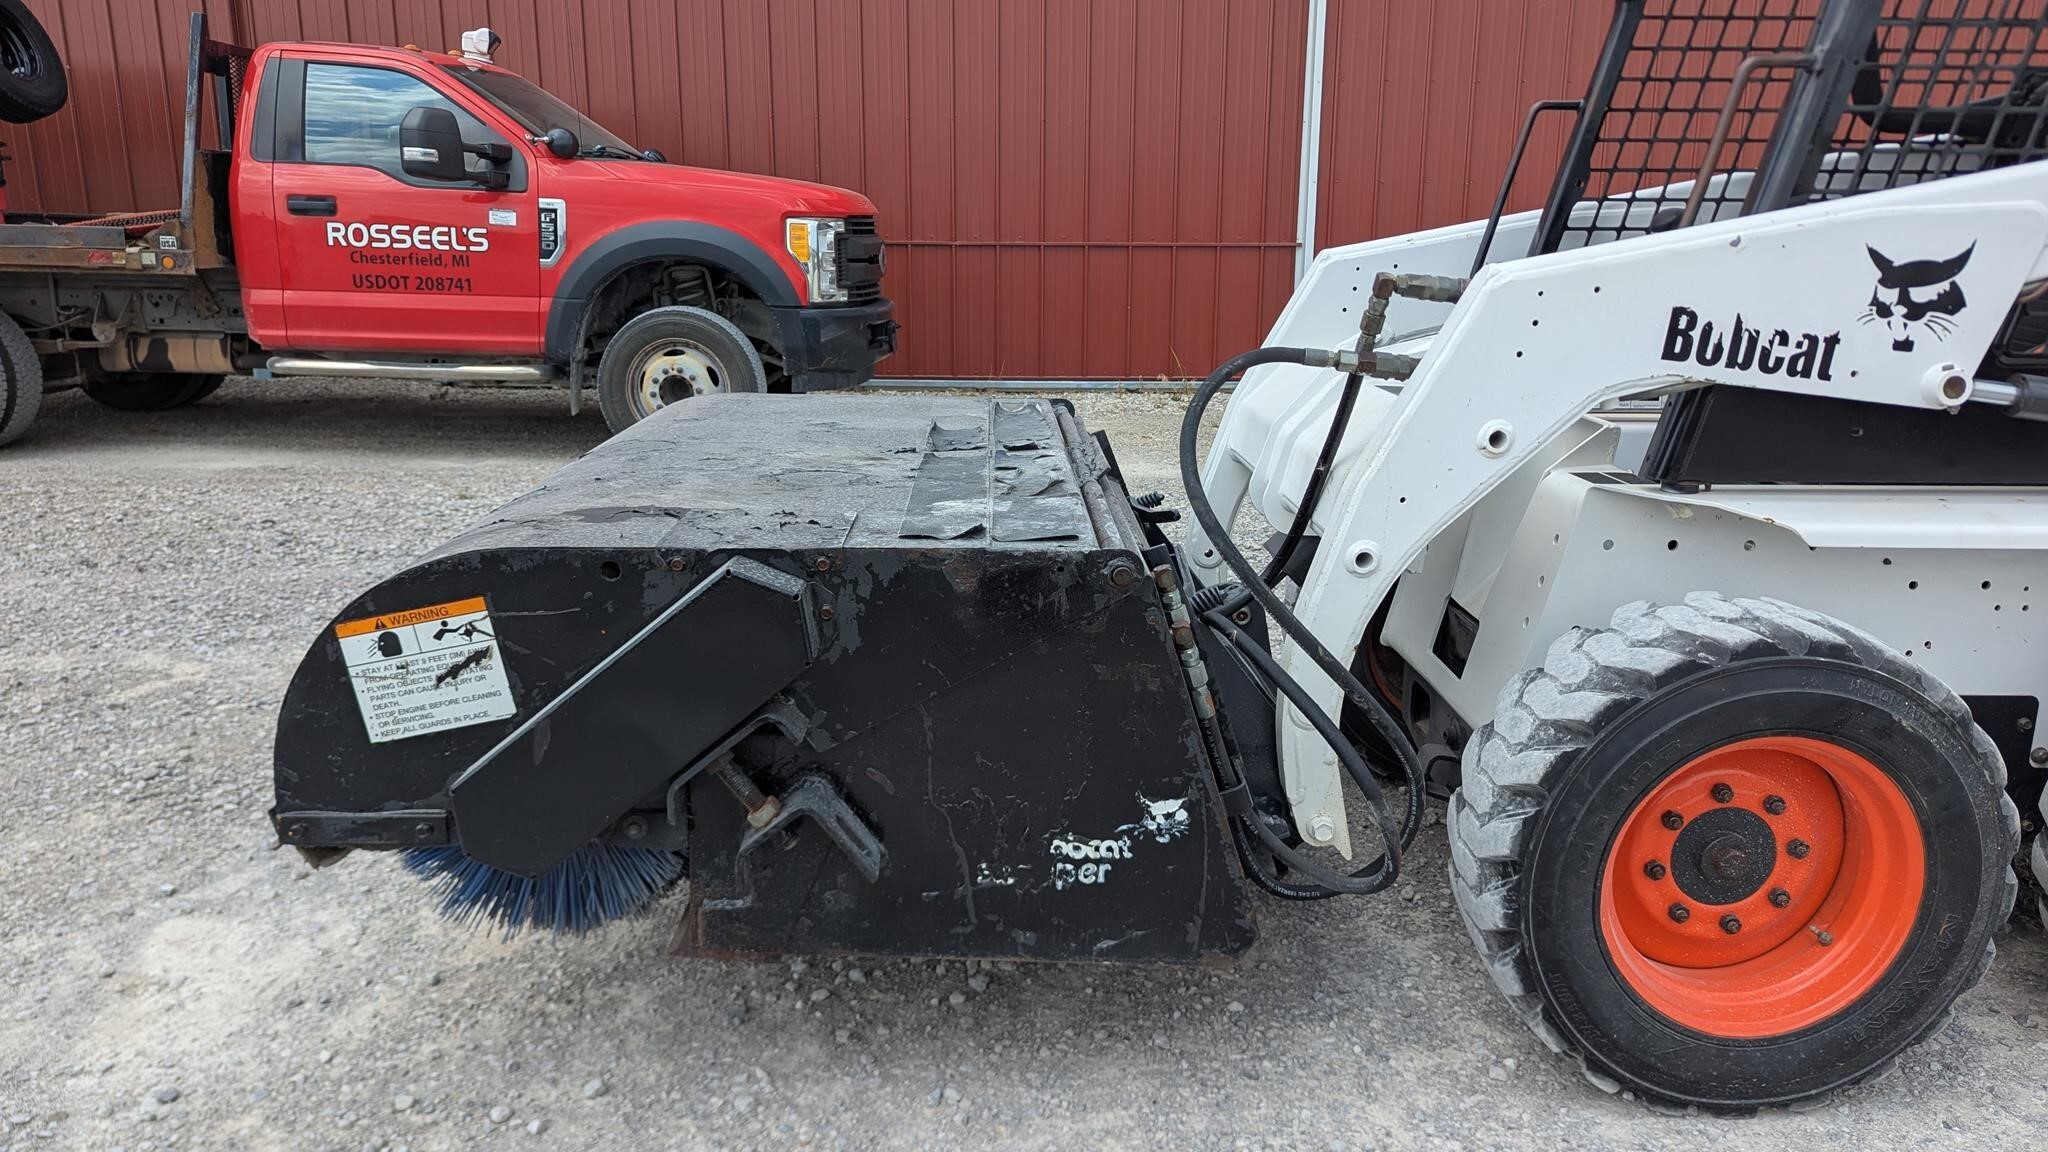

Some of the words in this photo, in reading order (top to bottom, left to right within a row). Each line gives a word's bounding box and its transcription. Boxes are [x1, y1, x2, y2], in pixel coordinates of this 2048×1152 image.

[326, 221, 489, 252] ROSSEEL'S
[350, 250, 448, 268] Chesterfield,
[452, 254, 470, 267] MI
[352, 274, 410, 290] USDOT
[415, 276, 472, 292] 208741
[1661, 305, 1841, 382] Bobcat
[388, 606, 449, 626] WARNING
[361, 666, 381, 676] STAY
[384, 664, 393, 672] AT
[428, 654, 448, 663] FEET
[364, 674, 389, 684] FROM
[390, 665, 435, 680] OPERATING
[366, 682, 395, 693] FLYING
[396, 675, 433, 687] OBJECTS
[369, 692, 397, 702] PARTS
[398, 688, 414, 697] CAN
[474, 674, 487, 682] OR
[372, 700, 402, 711] DEATH.
[375, 710, 396, 720] STOP
[398, 704, 428, 715] ENGINE
[429, 698, 460, 709] BEFORE
[461, 690, 502, 703] CLEANING
[378, 720, 390, 728] OR
[380, 728, 400, 737] KEEP
[402, 724, 417, 734] ALL
[419, 717, 452, 729] GUARDS
